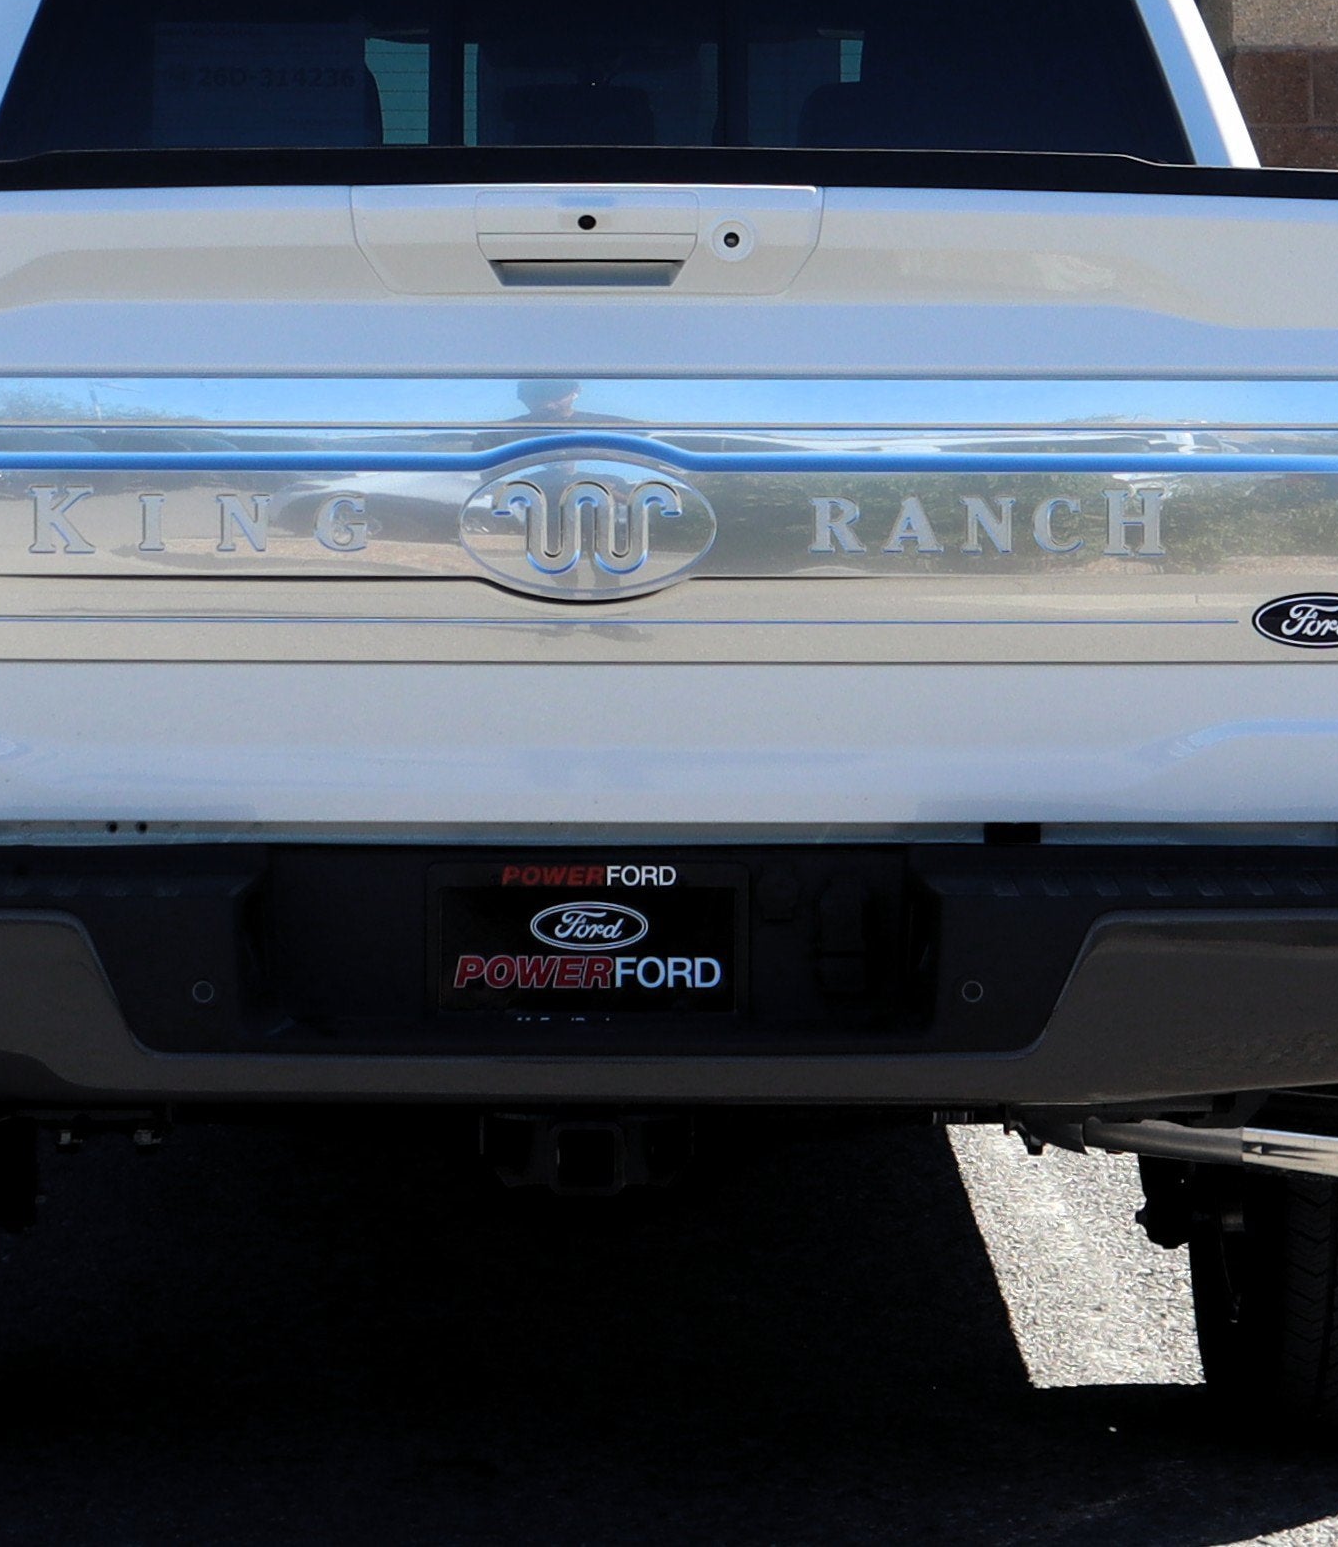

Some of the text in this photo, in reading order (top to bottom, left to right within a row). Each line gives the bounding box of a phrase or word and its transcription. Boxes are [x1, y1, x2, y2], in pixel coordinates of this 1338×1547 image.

[29, 484, 1168, 557] KING RANCH
[554, 910, 624, 941] Ford
